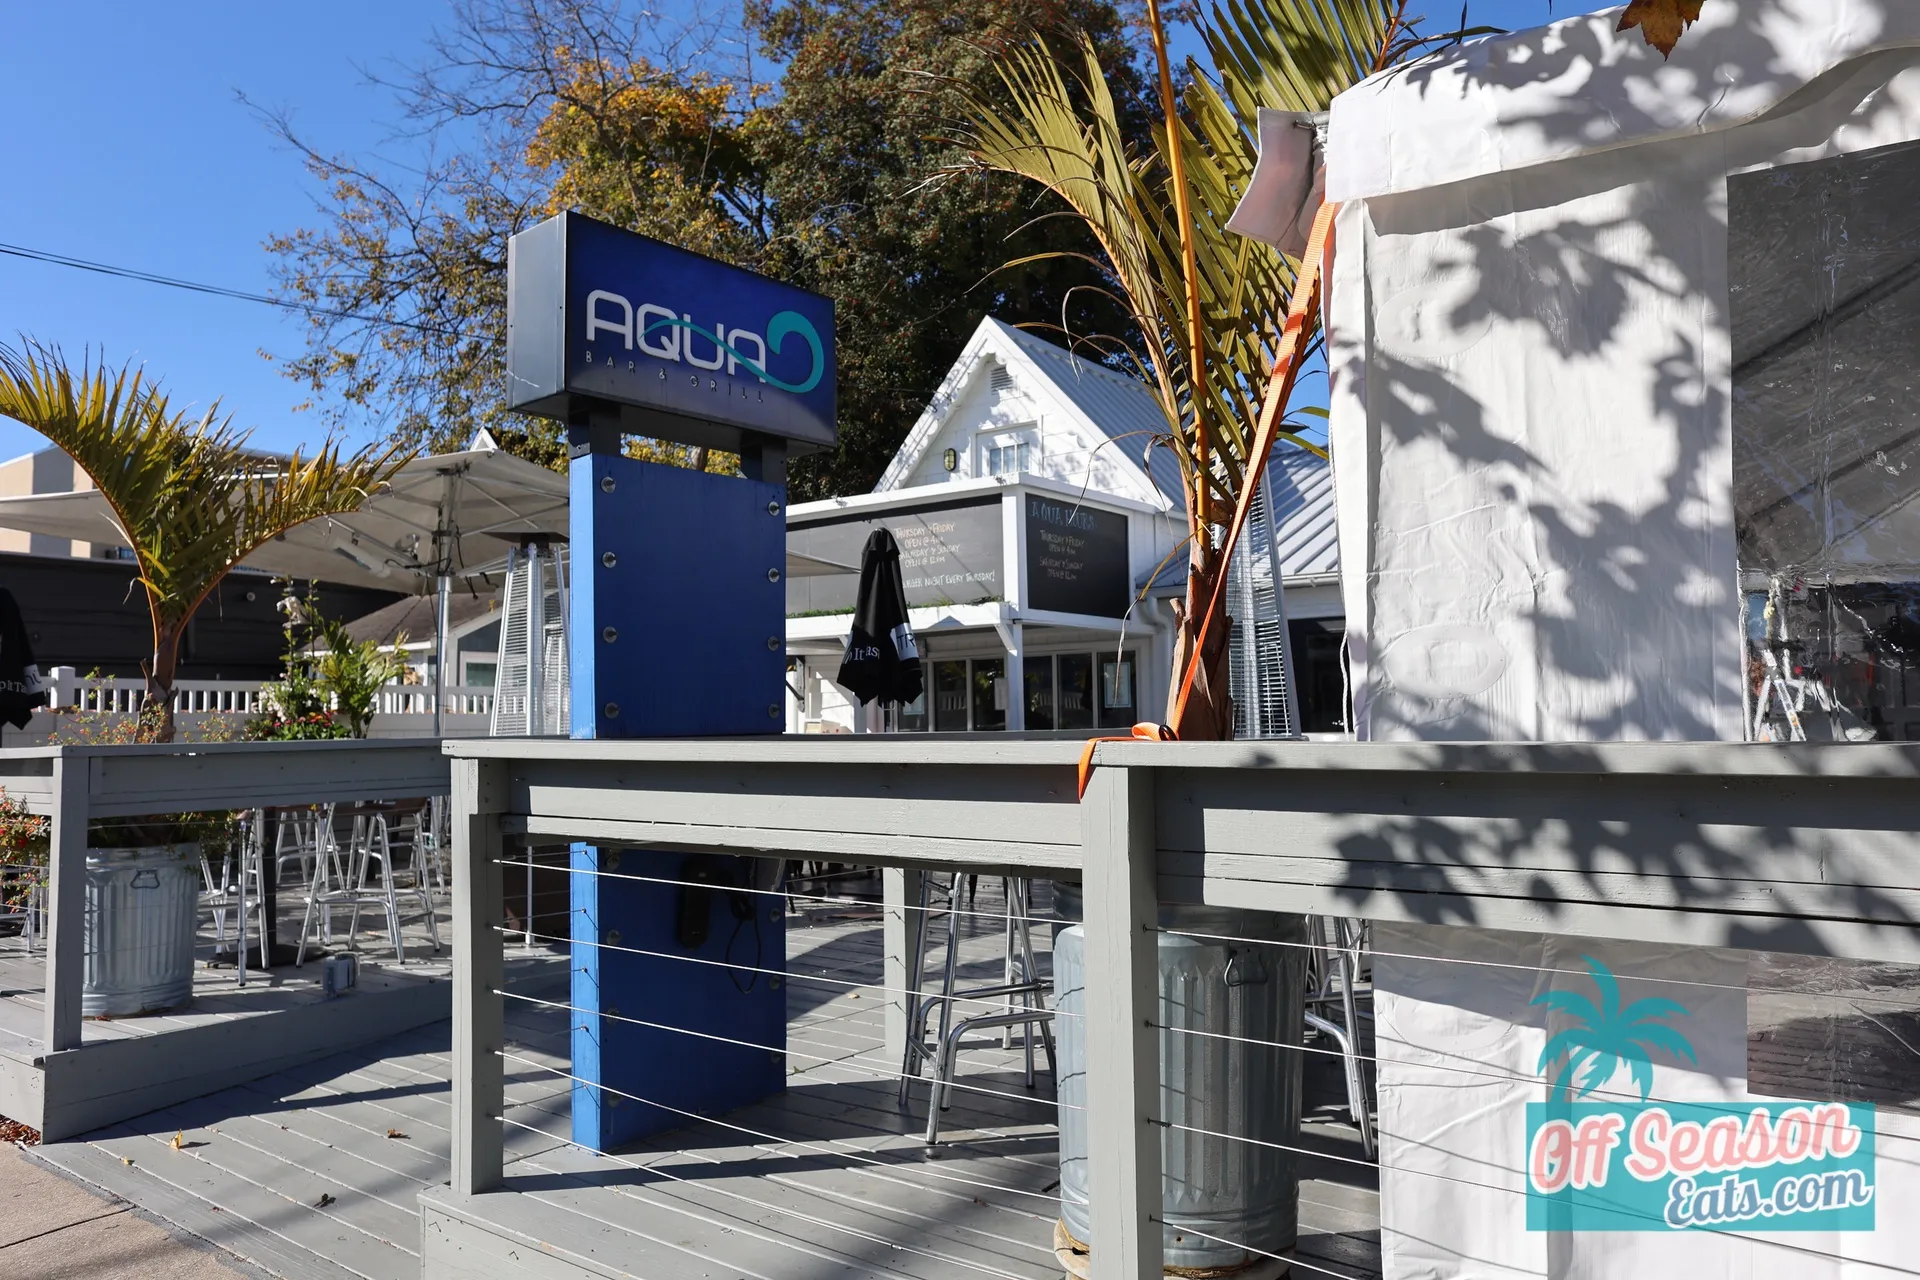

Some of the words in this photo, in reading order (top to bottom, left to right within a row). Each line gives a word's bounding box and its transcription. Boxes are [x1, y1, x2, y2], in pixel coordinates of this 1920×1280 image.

[587, 289, 766, 383] AQUA
[586, 351, 635, 374] BAR
[658, 368, 667, 380] &
[690, 375, 763, 403] GRILL
[1032, 501, 1063, 526] AQUA
[894, 527, 926, 539] THURSDAY
[932, 523, 955, 533] FRIDAY
[904, 537, 922, 549] OPEN
[937, 544, 960, 555] SUNDAY
[904, 558, 920, 568] OPEN
[925, 574, 945, 586] NIGHT
[945, 573, 964, 584] EVERY
[896, 633, 916, 651] TR
